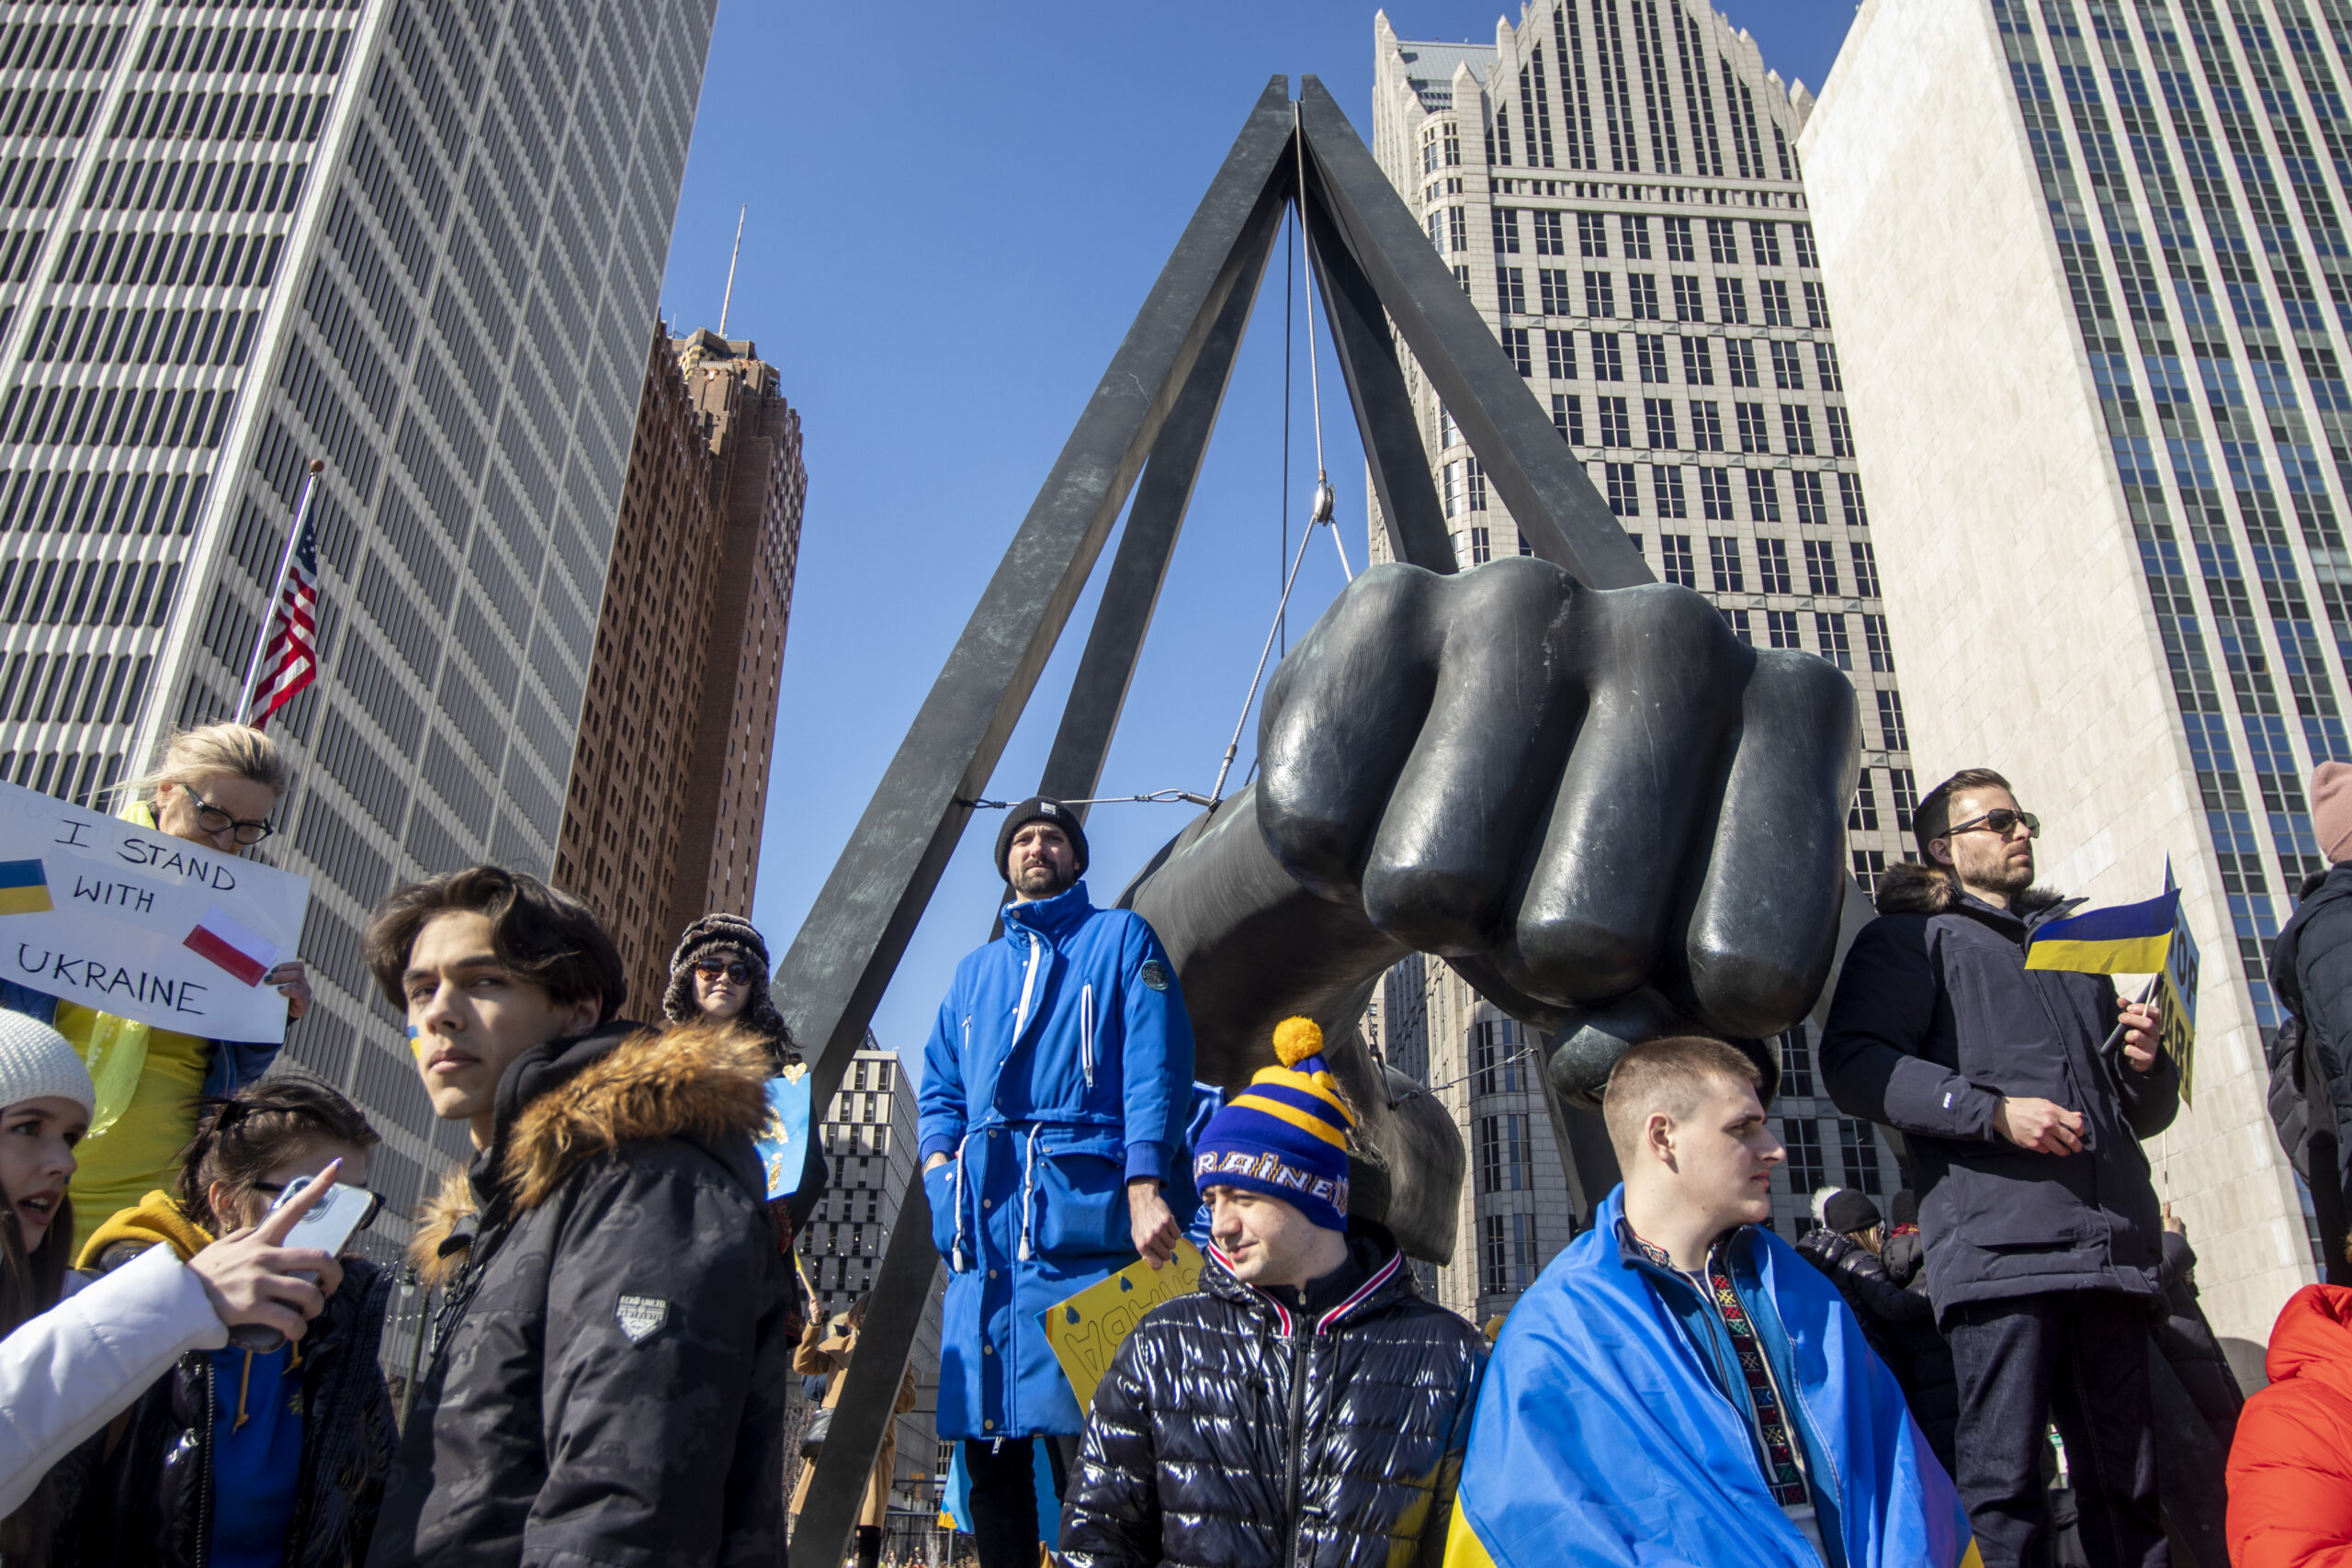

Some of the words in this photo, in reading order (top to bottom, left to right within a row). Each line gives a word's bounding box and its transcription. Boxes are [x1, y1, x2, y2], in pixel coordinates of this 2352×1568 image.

[53, 818, 93, 849] I
[115, 837, 237, 892] STAND
[73, 875, 155, 913] WITH
[18, 943, 208, 1015] UKRAINE
[2166, 882, 2198, 1006] TOP
